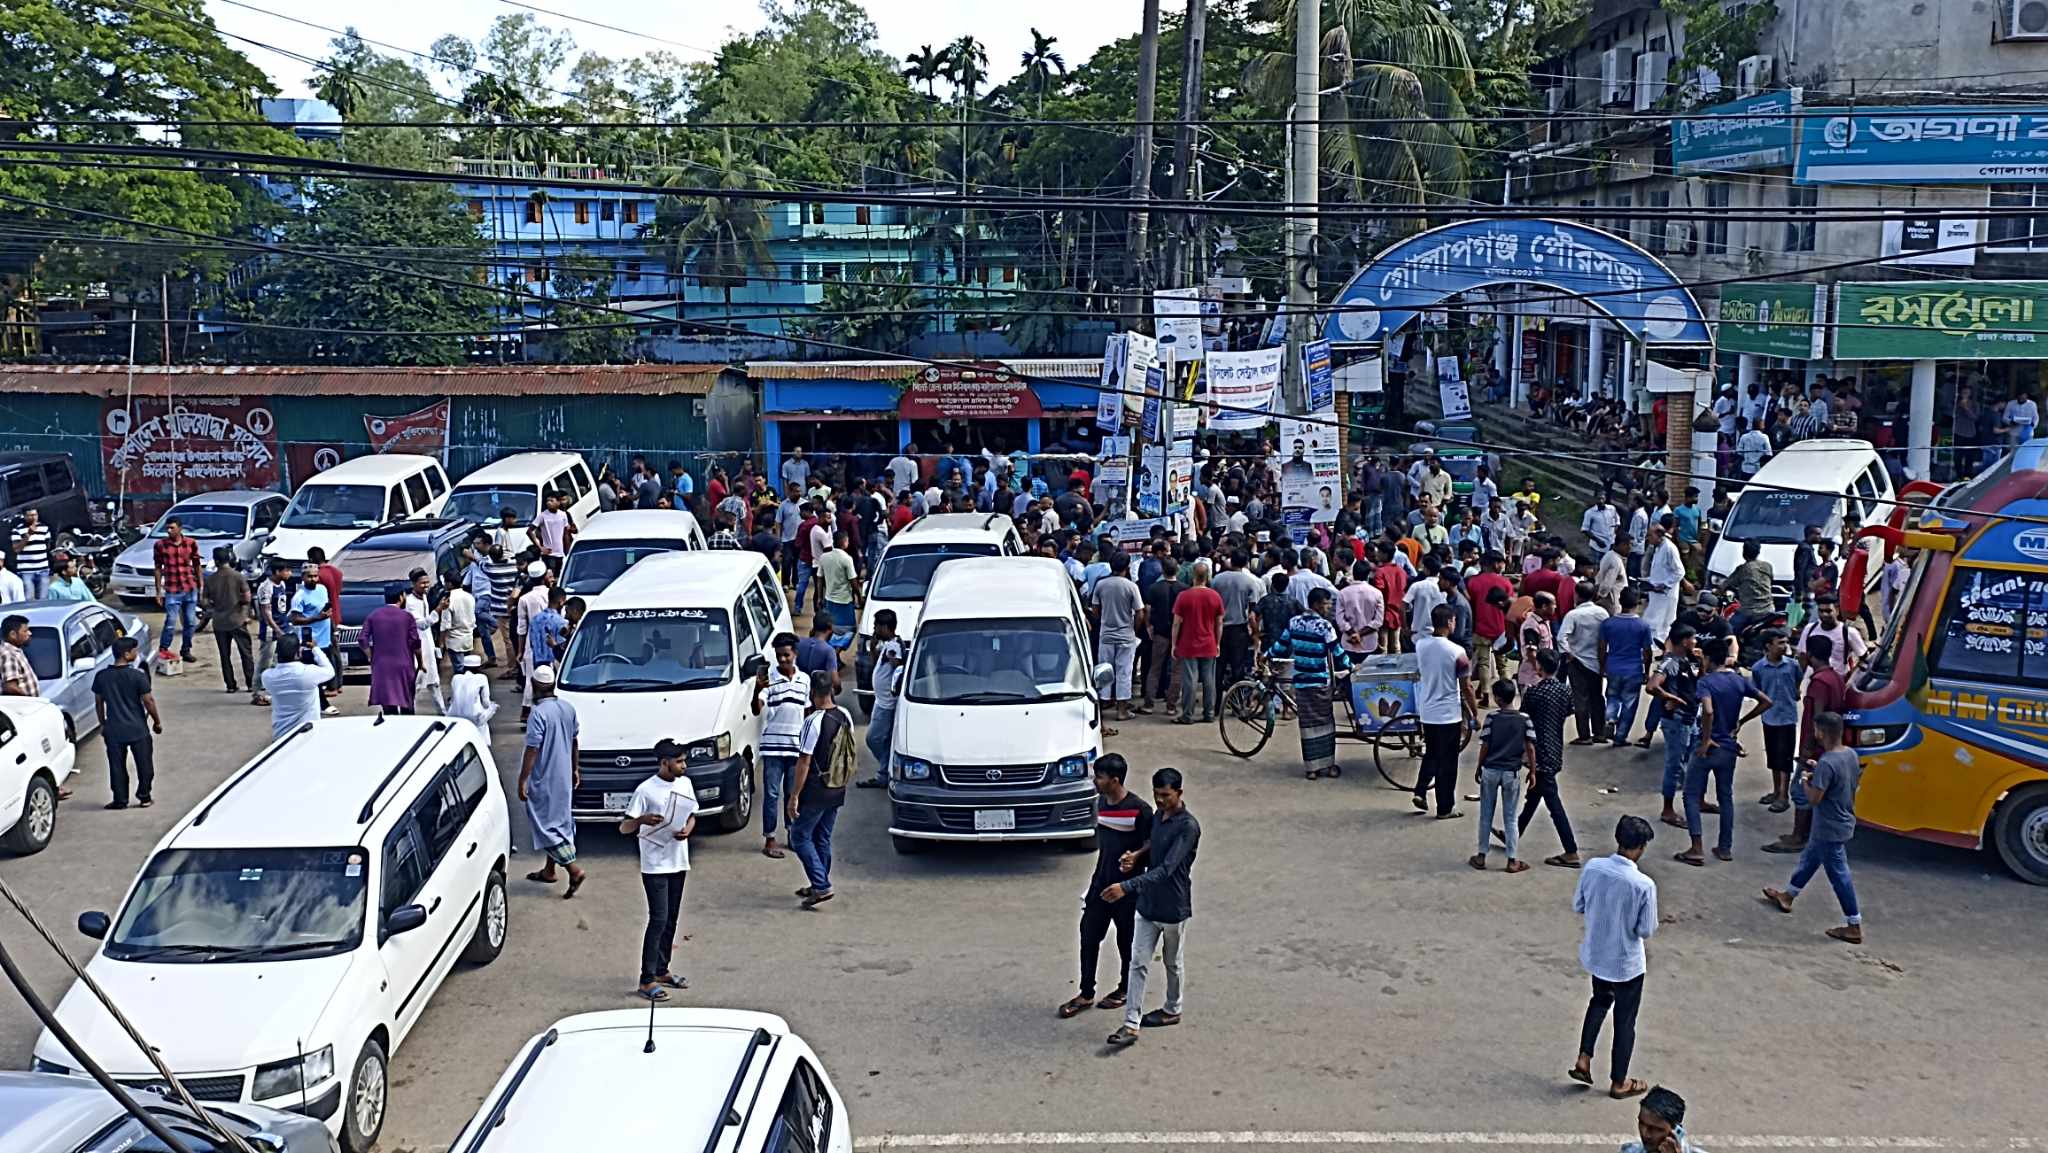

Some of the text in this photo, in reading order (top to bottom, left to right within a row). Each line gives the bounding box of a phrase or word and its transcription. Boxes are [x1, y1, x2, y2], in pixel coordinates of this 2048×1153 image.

[1870, 115, 2021, 142] অগ্রণী
[1380, 225, 1646, 303] গোলাপগঞ্জ পৌরসভা
[109, 405, 274, 472] বাংলাদেশ মুক্তিযোদ্ধা সংসদ
